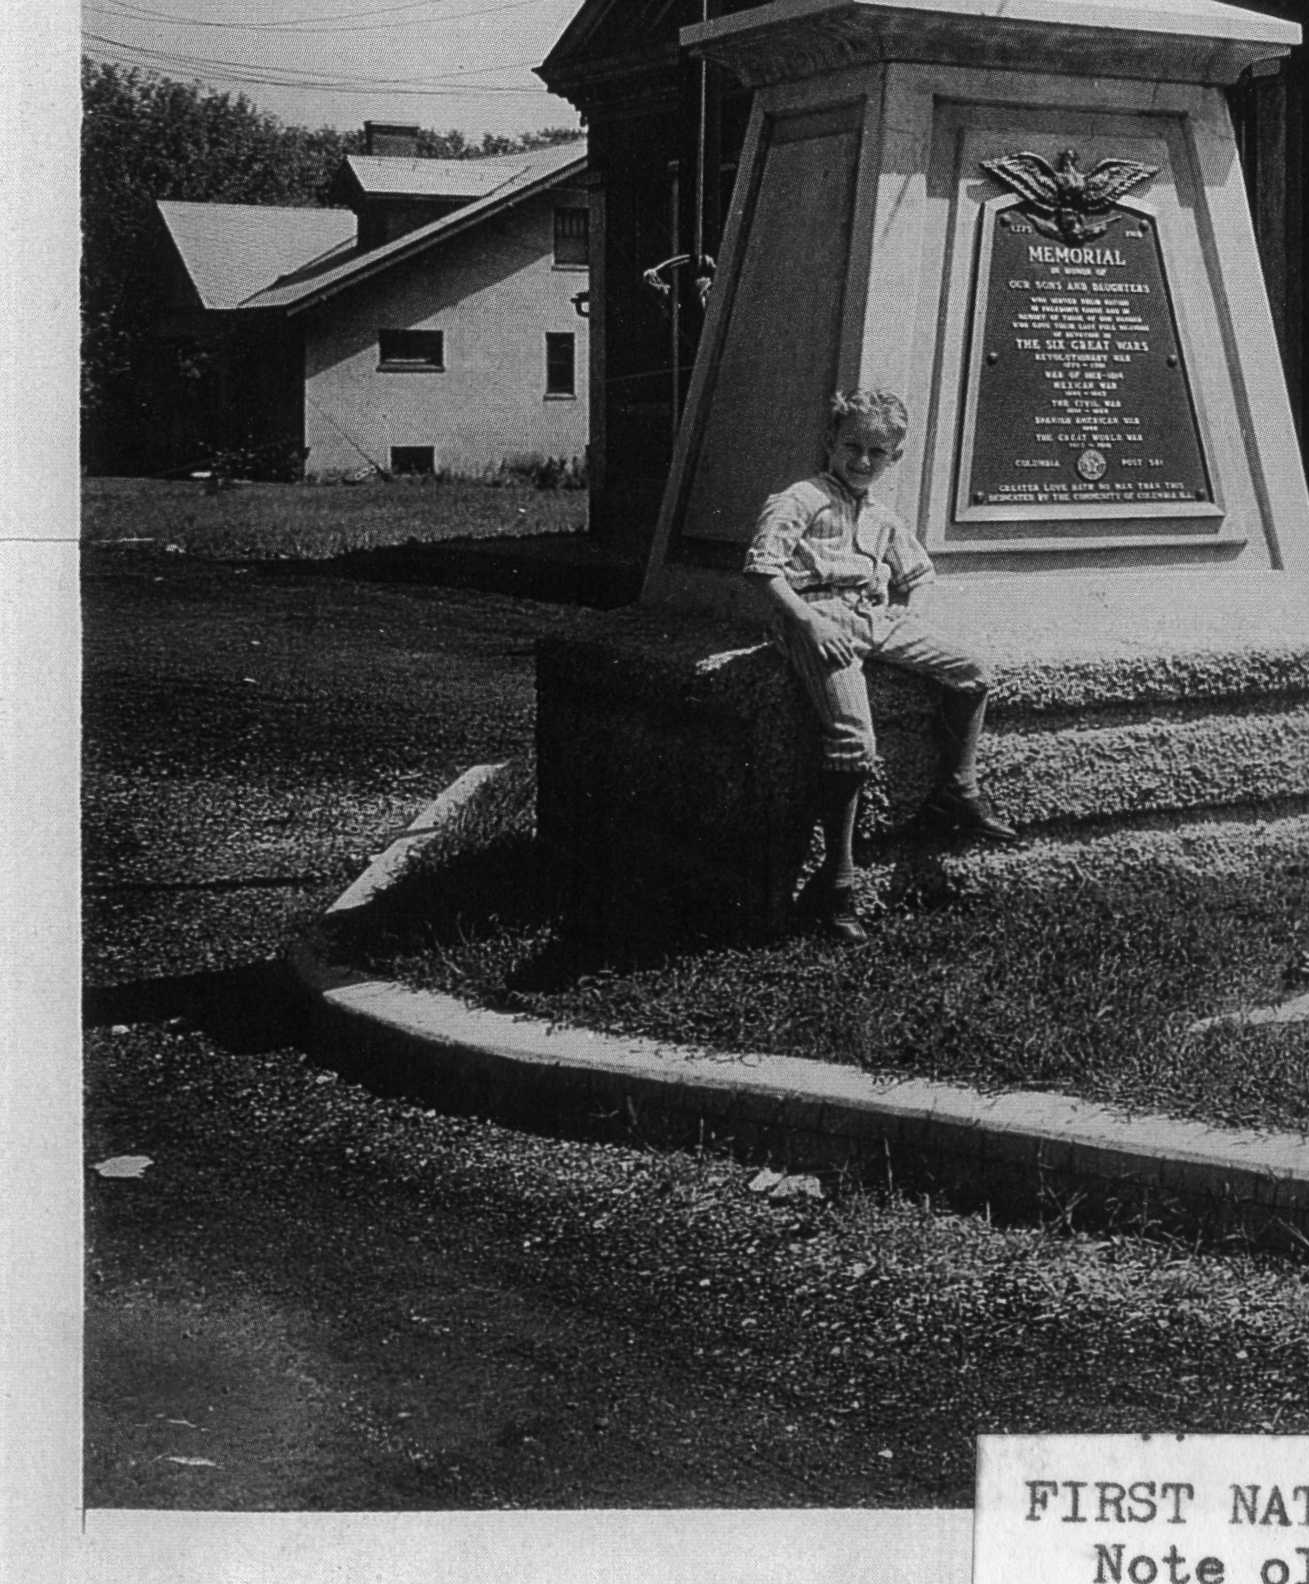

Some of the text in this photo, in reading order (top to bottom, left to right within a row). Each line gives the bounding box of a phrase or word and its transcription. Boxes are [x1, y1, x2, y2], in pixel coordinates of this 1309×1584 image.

[1027, 245, 1127, 266] MEMORIAL
[1009, 280, 1151, 293] OUR SONS AND DAUGHTERS
[1015, 337, 1150, 352] THE SIX GREAT WARS
[1034, 353, 1132, 362] REVOLUTIONARY WAR
[1044, 370, 1064, 379] WAR
[1068, 370, 1081, 379] OF
[1053, 381, 1118, 390] MEXICAN WAR
[1051, 399, 1122, 408] THE CIVIL WAR
[1075, 416, 1119, 424] AMERICAN
[1123, 417, 1141, 425] WAR
[1036, 433, 1144, 442] THE GREAT WORLD WAR
[1015, 459, 1061, 467] COLUMBIA
[1121, 458, 1143, 466] POST
[999, 484, 1040, 492] GREATER
[1043, 483, 1068, 492] LOVE
[1098, 483, 1111, 491] NO
[1114, 482, 1134, 491] MAN
[1138, 482, 1161, 490] THAN
[1037, 493, 1050, 502] BY
[1052, 493, 1071, 501] THE
[1123, 492, 1134, 500] OF
